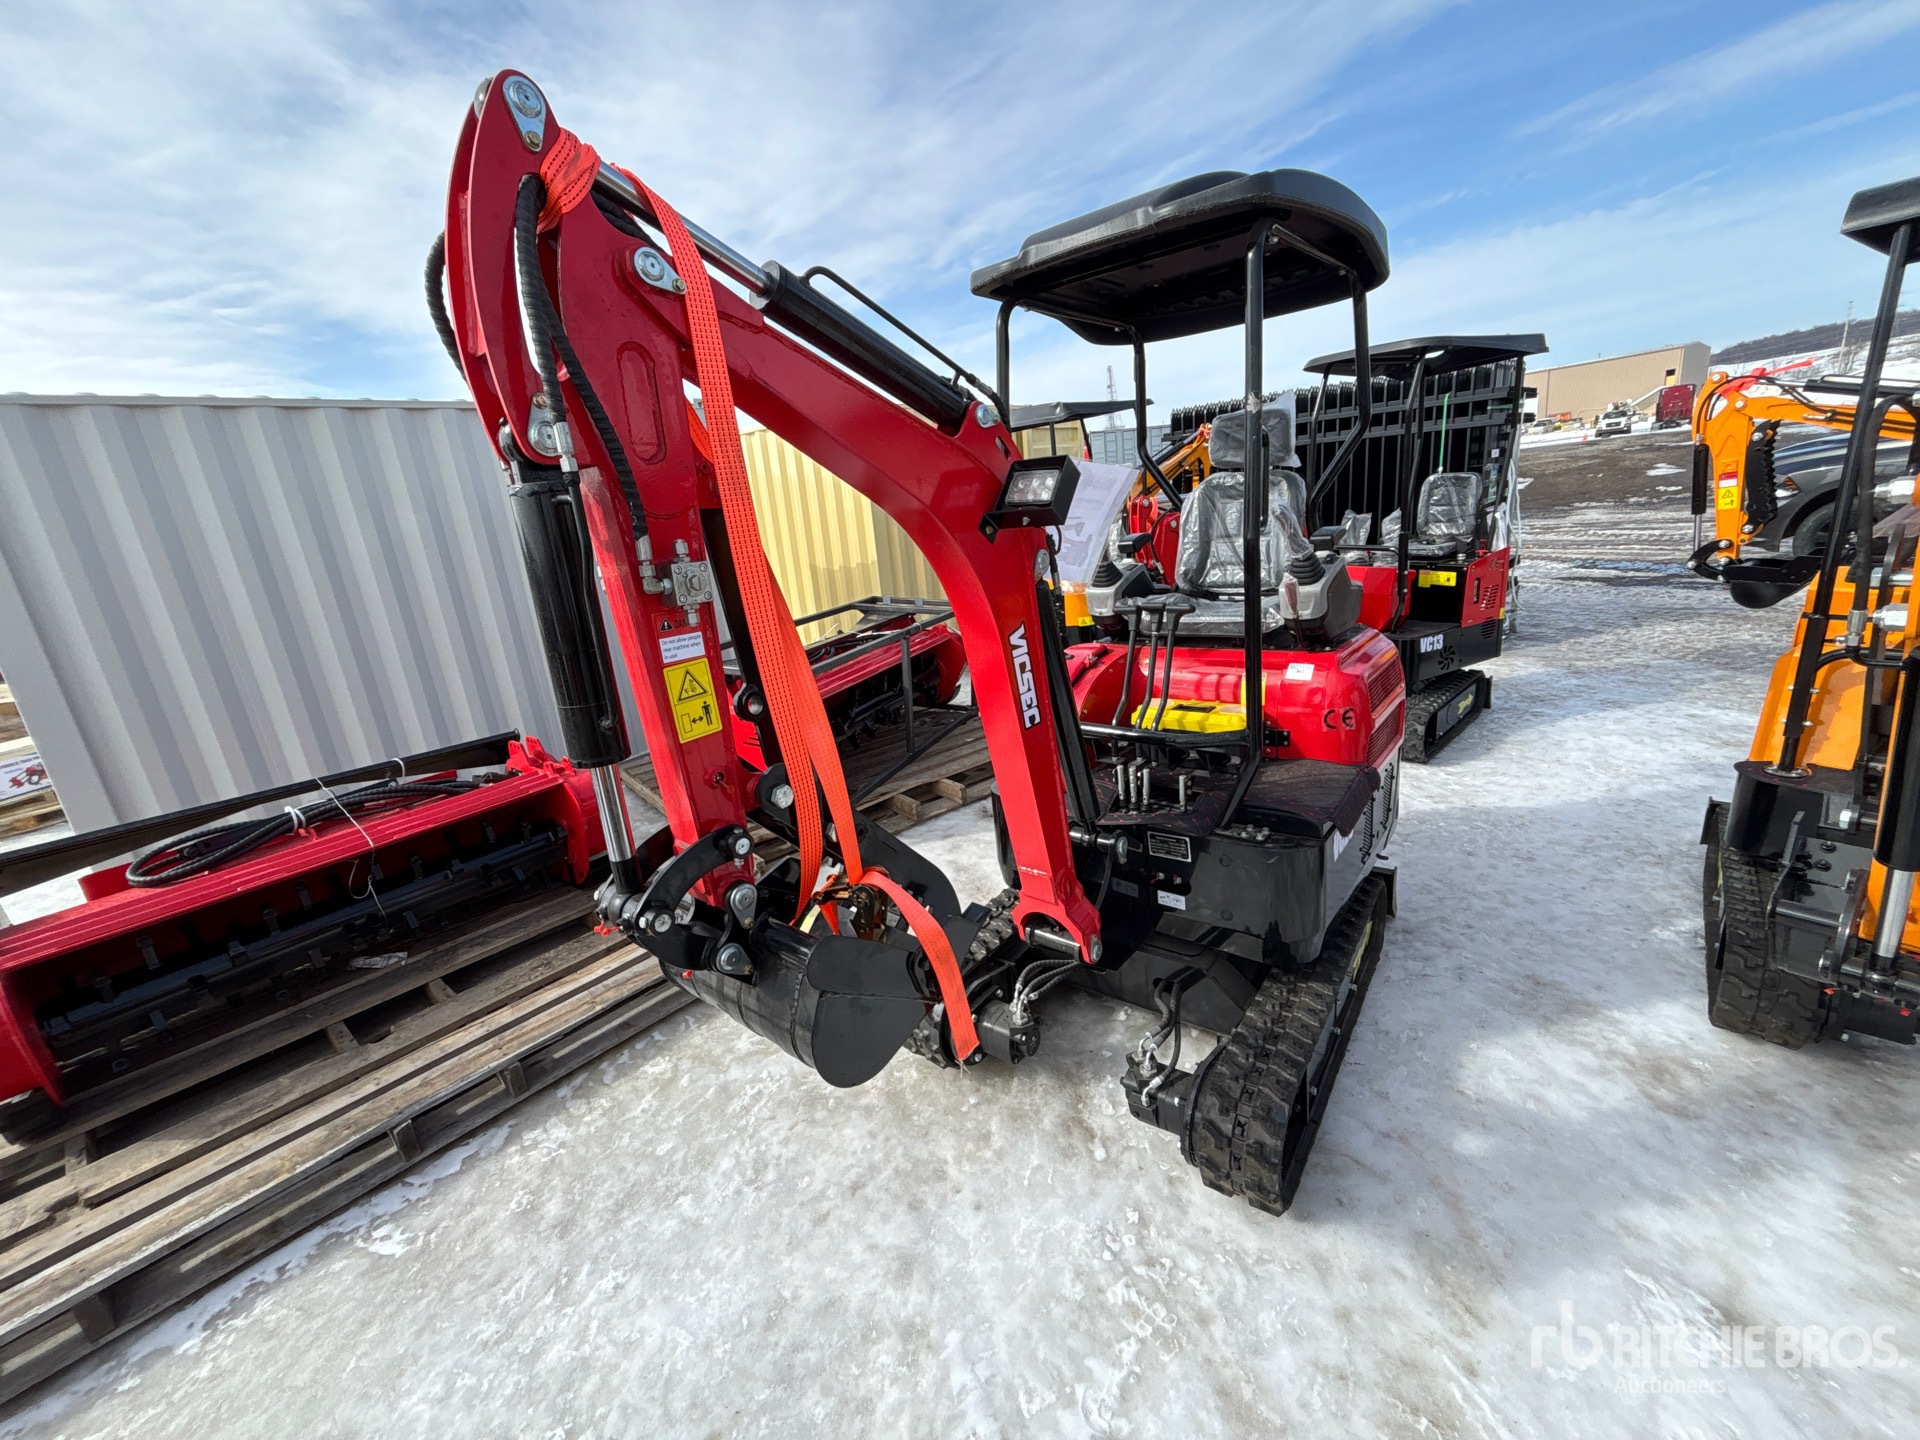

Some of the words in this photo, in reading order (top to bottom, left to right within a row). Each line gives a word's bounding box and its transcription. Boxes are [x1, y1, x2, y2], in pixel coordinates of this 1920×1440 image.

[1420, 634, 1444, 653] VC13
[1008, 622, 1041, 729] VICSEC
[1323, 707, 1354, 730] CE
